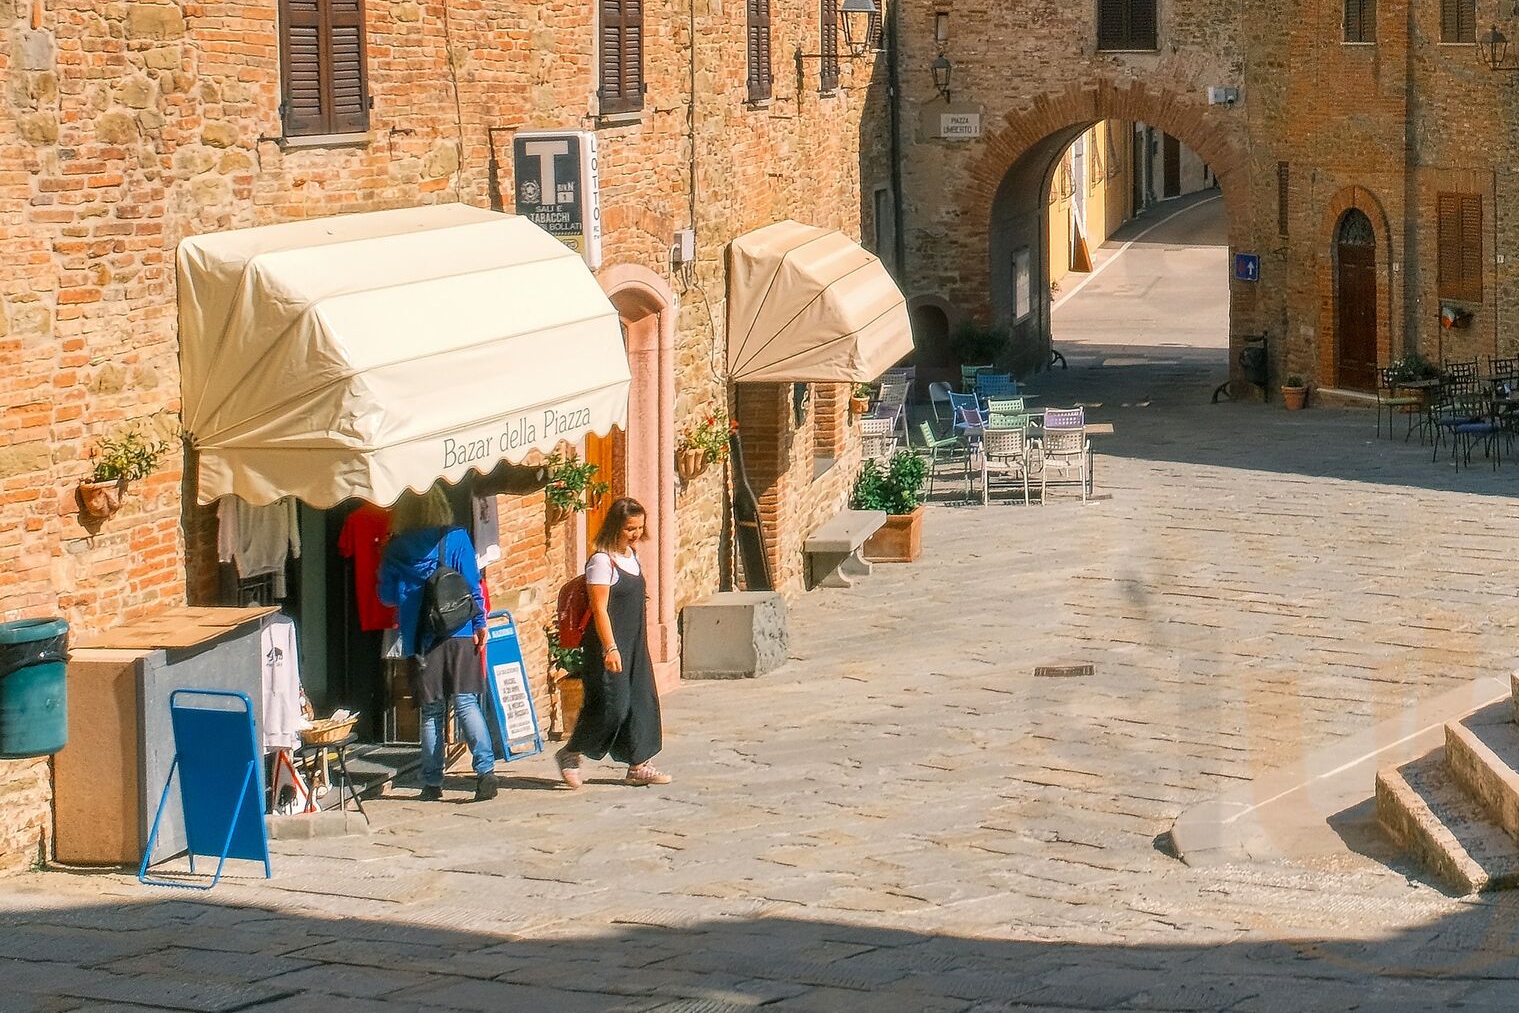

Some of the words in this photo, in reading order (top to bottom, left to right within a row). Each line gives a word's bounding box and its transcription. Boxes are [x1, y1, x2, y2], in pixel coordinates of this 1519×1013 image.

[525, 140, 569, 206] T
[590, 139, 600, 221] LOTTO
[531, 212, 570, 223] TABACCHI
[535, 205, 554, 213] SALI
[556, 204, 563, 212] E
[550, 222, 582, 231] BOLLATI
[443, 436, 492, 469] Bazar
[500, 417, 536, 452] della
[543, 407, 591, 439] Piazza
